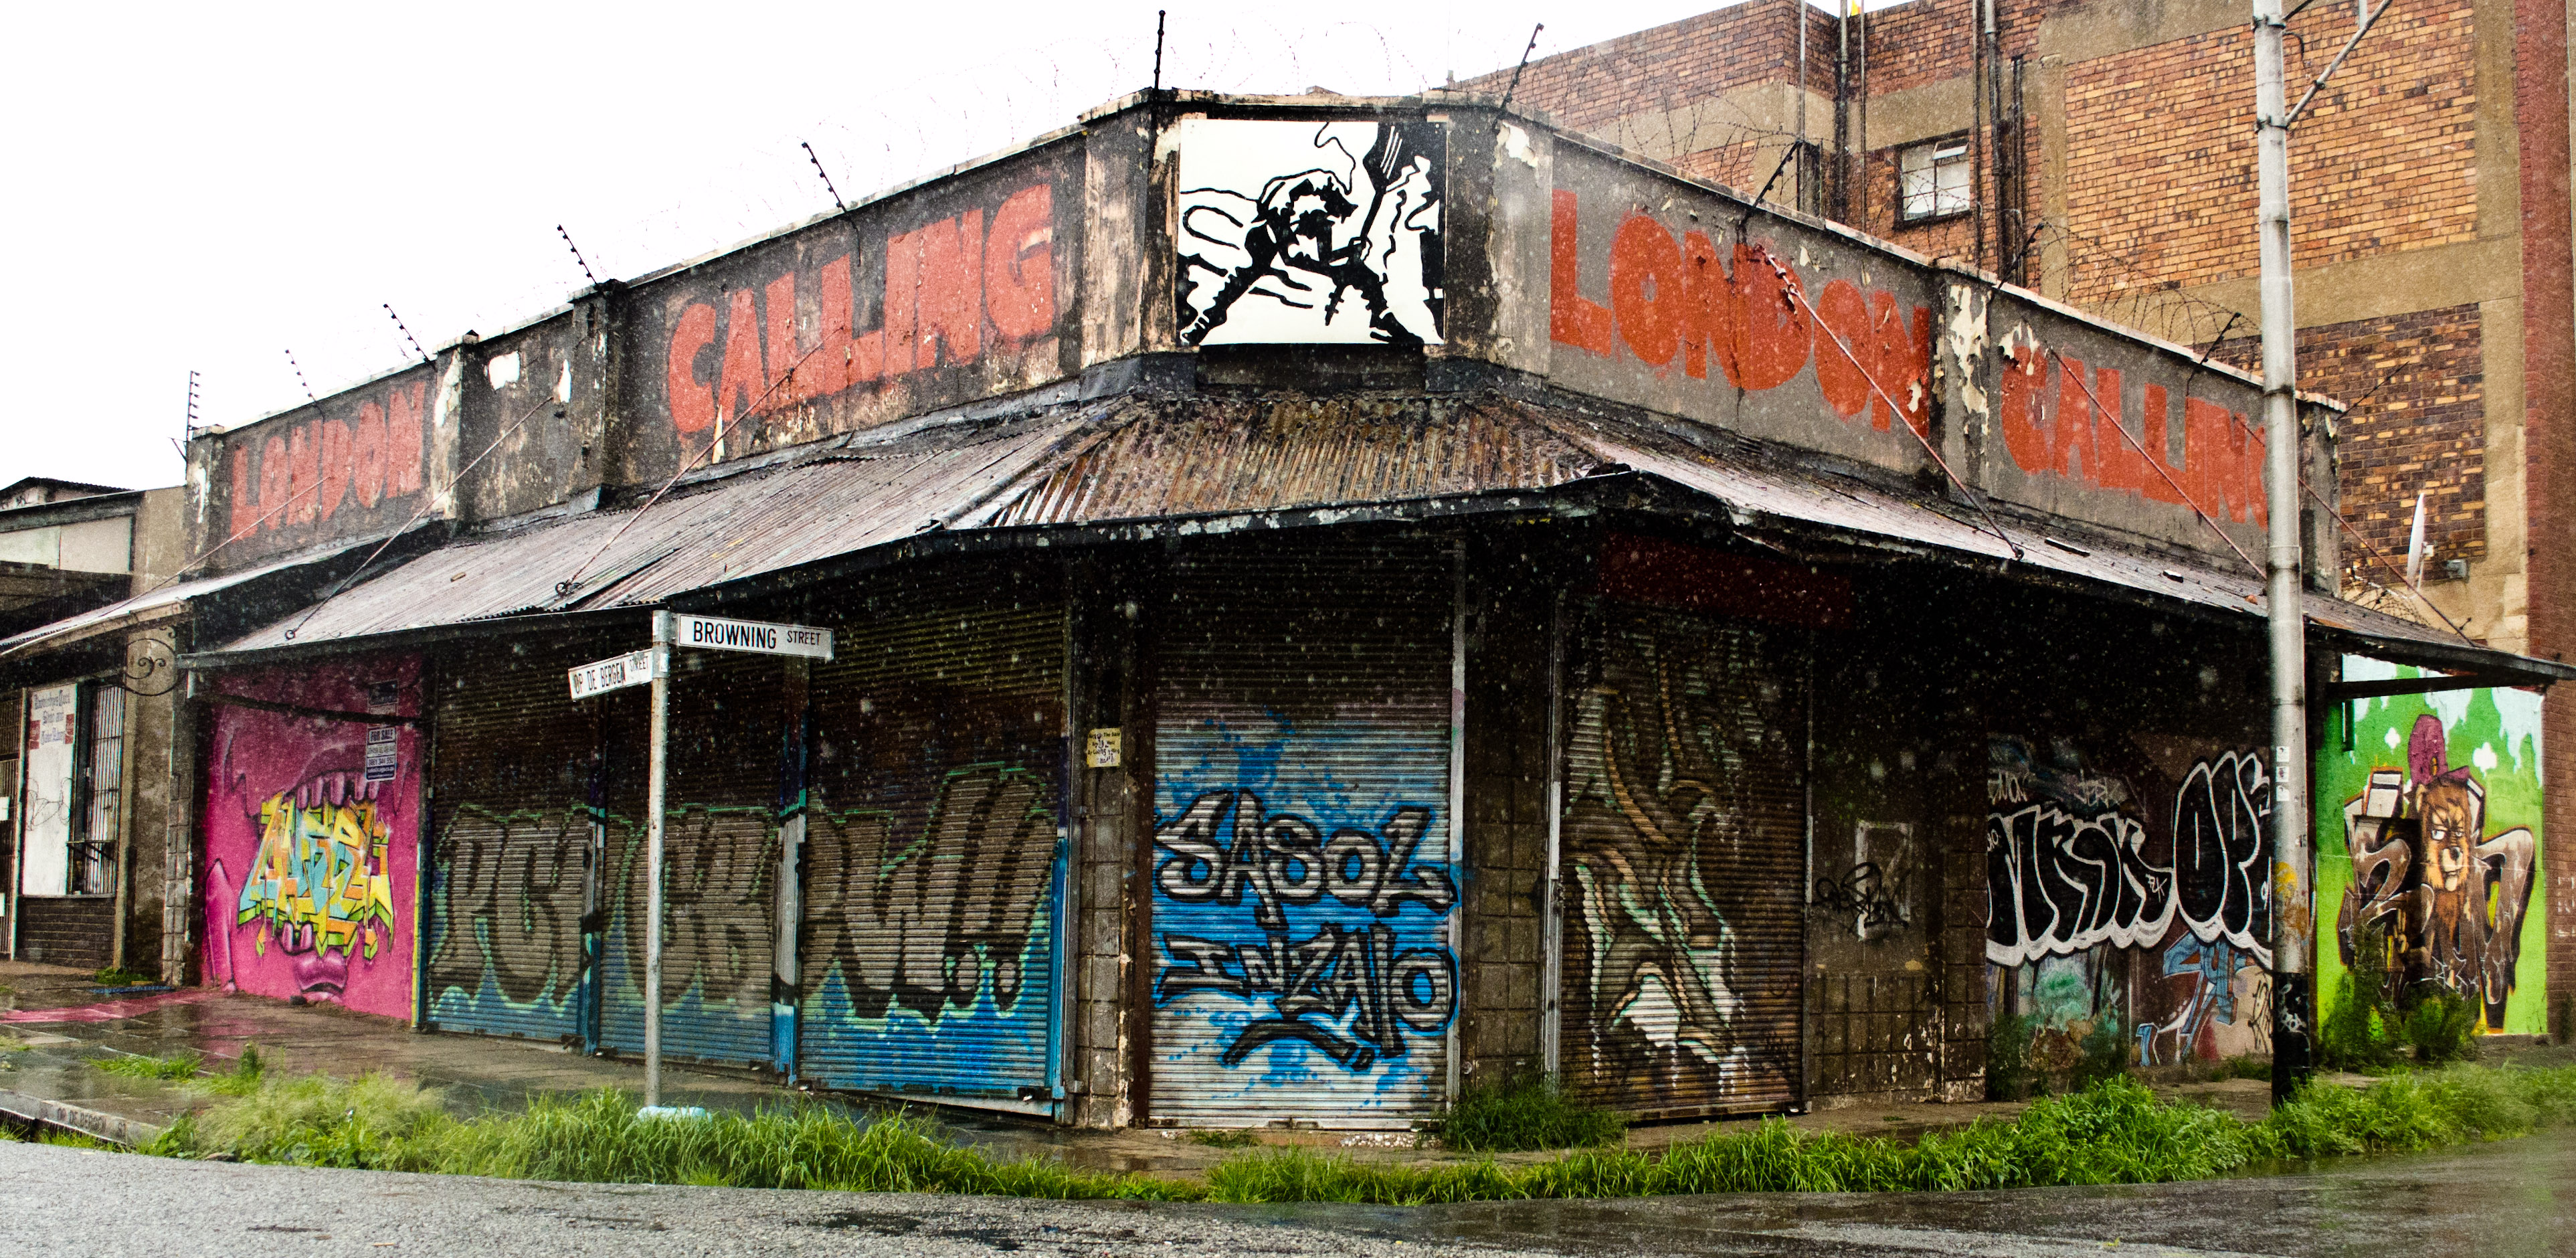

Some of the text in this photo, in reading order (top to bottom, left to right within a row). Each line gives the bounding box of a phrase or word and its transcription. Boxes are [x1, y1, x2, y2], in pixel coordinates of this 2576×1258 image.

[1550, 189, 1930, 438] LONDON
[231, 184, 1054, 543] LONDON CALLING
[574, 673, 583, 695] OP
[587, 669, 597, 691] DE
[600, 661, 626, 688] BERGEN
[693, 620, 821, 649] BROWNING STREET
[371, 729, 393, 742] FOR SALE
[1154, 788, 1459, 930] SASOL
